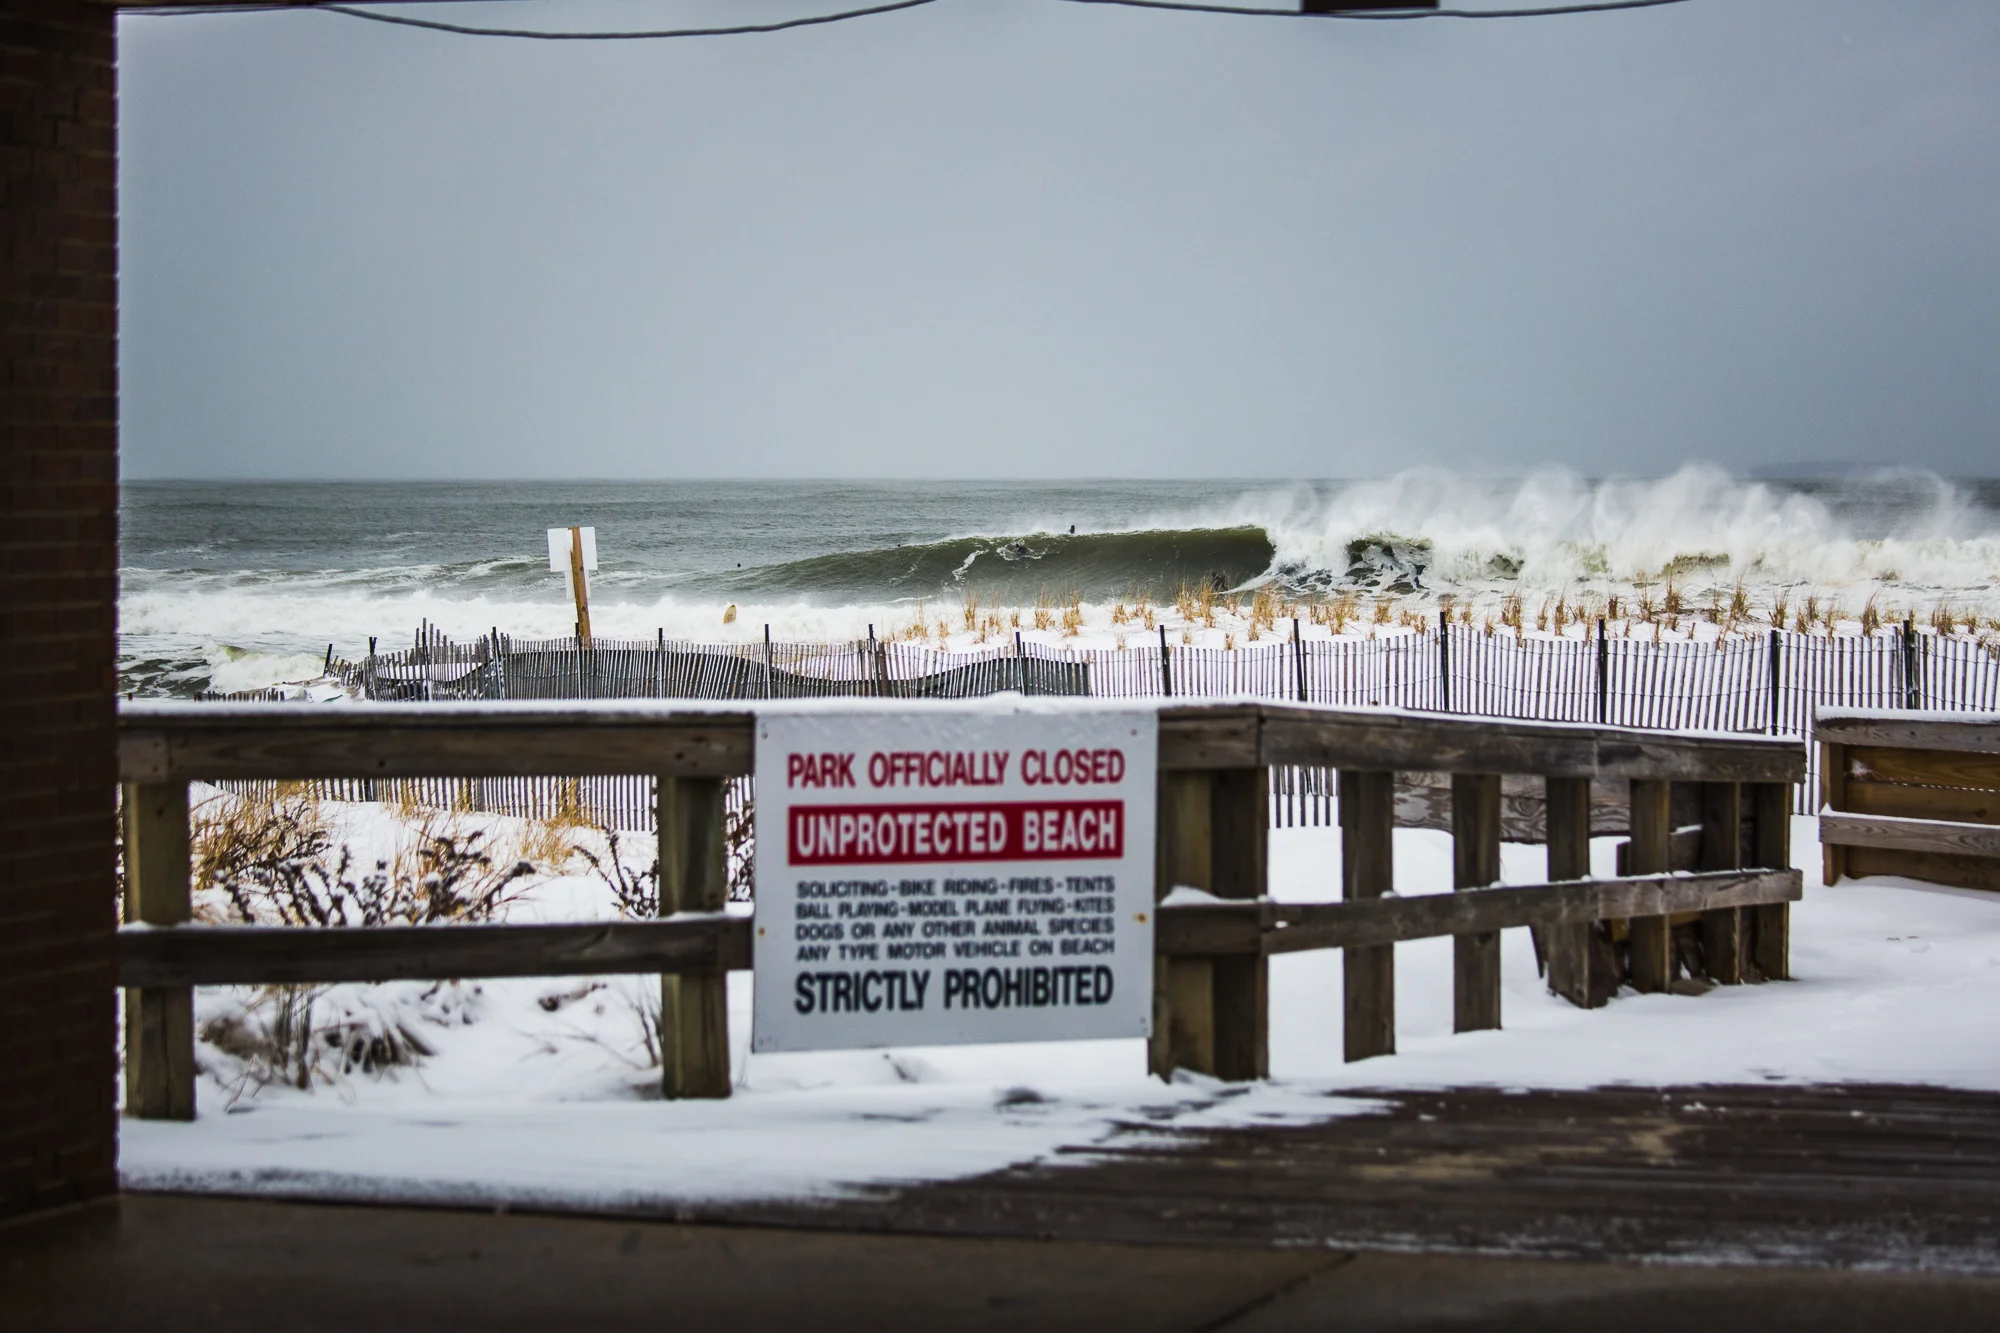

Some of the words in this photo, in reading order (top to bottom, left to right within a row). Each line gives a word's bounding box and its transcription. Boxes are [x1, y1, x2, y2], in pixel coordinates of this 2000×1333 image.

[787, 752, 856, 788] PARK
[868, 751, 1009, 787] OFFICIALLY
[1020, 748, 1126, 785] CLOSED
[797, 811, 1007, 857] UNPROTECTED
[1023, 808, 1117, 851] BEACH
[796, 901, 831, 919] BALL
[964, 898, 1010, 916] PLANE
[796, 923, 844, 941] DOGS
[851, 922, 875, 939] OR
[882, 922, 915, 938] ANY
[921, 920, 976, 937] OTHER
[982, 919, 1040, 935] ANIMAL
[1048, 917, 1114, 934] SPECIES
[797, 945, 830, 961] ANY
[838, 943, 878, 960] TYPE
[887, 941, 946, 959] MOTOR
[953, 940, 1021, 958] VEHICLE
[1029, 939, 1053, 956] ON
[1060, 938, 1115, 955] BEACH
[795, 969, 931, 1016] STRICTLY
[944, 965, 1114, 1010] PROHIBITED
